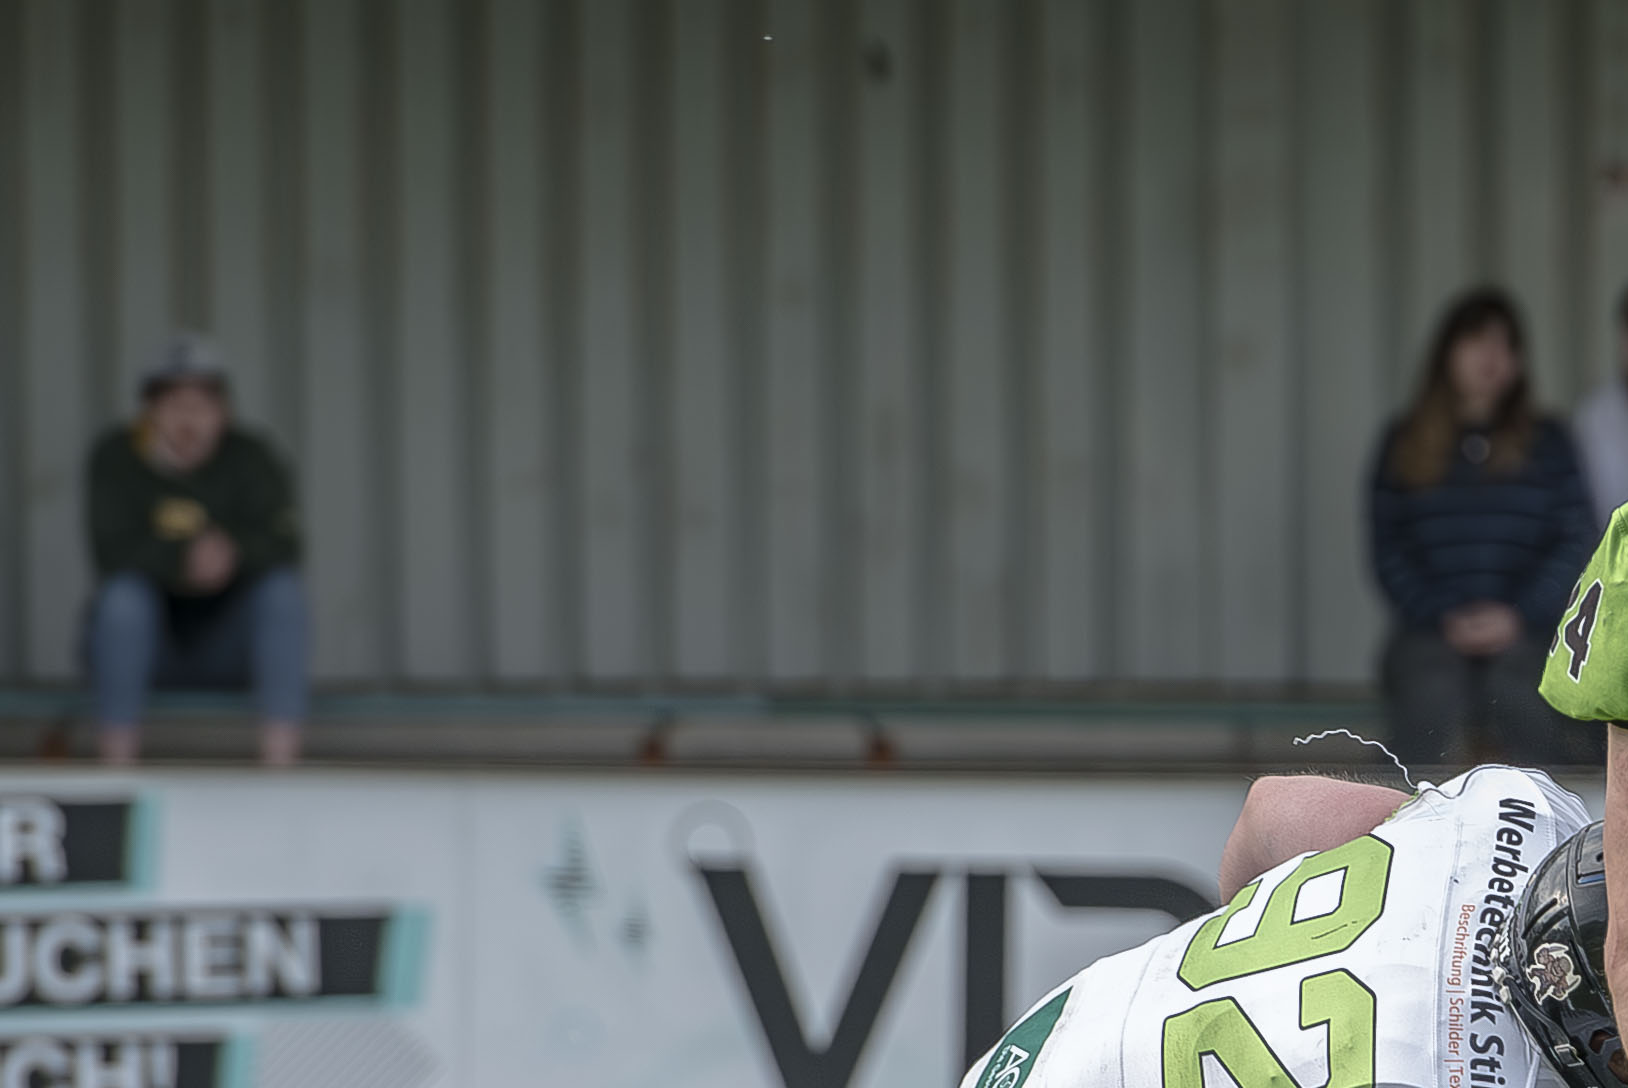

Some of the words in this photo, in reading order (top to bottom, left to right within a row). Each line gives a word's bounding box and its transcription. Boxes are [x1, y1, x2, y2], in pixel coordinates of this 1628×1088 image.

[1550, 576, 1604, 683] 4
[1447, 903, 1476, 987] Beschriftung
[1447, 997, 1464, 1056] Schilder
